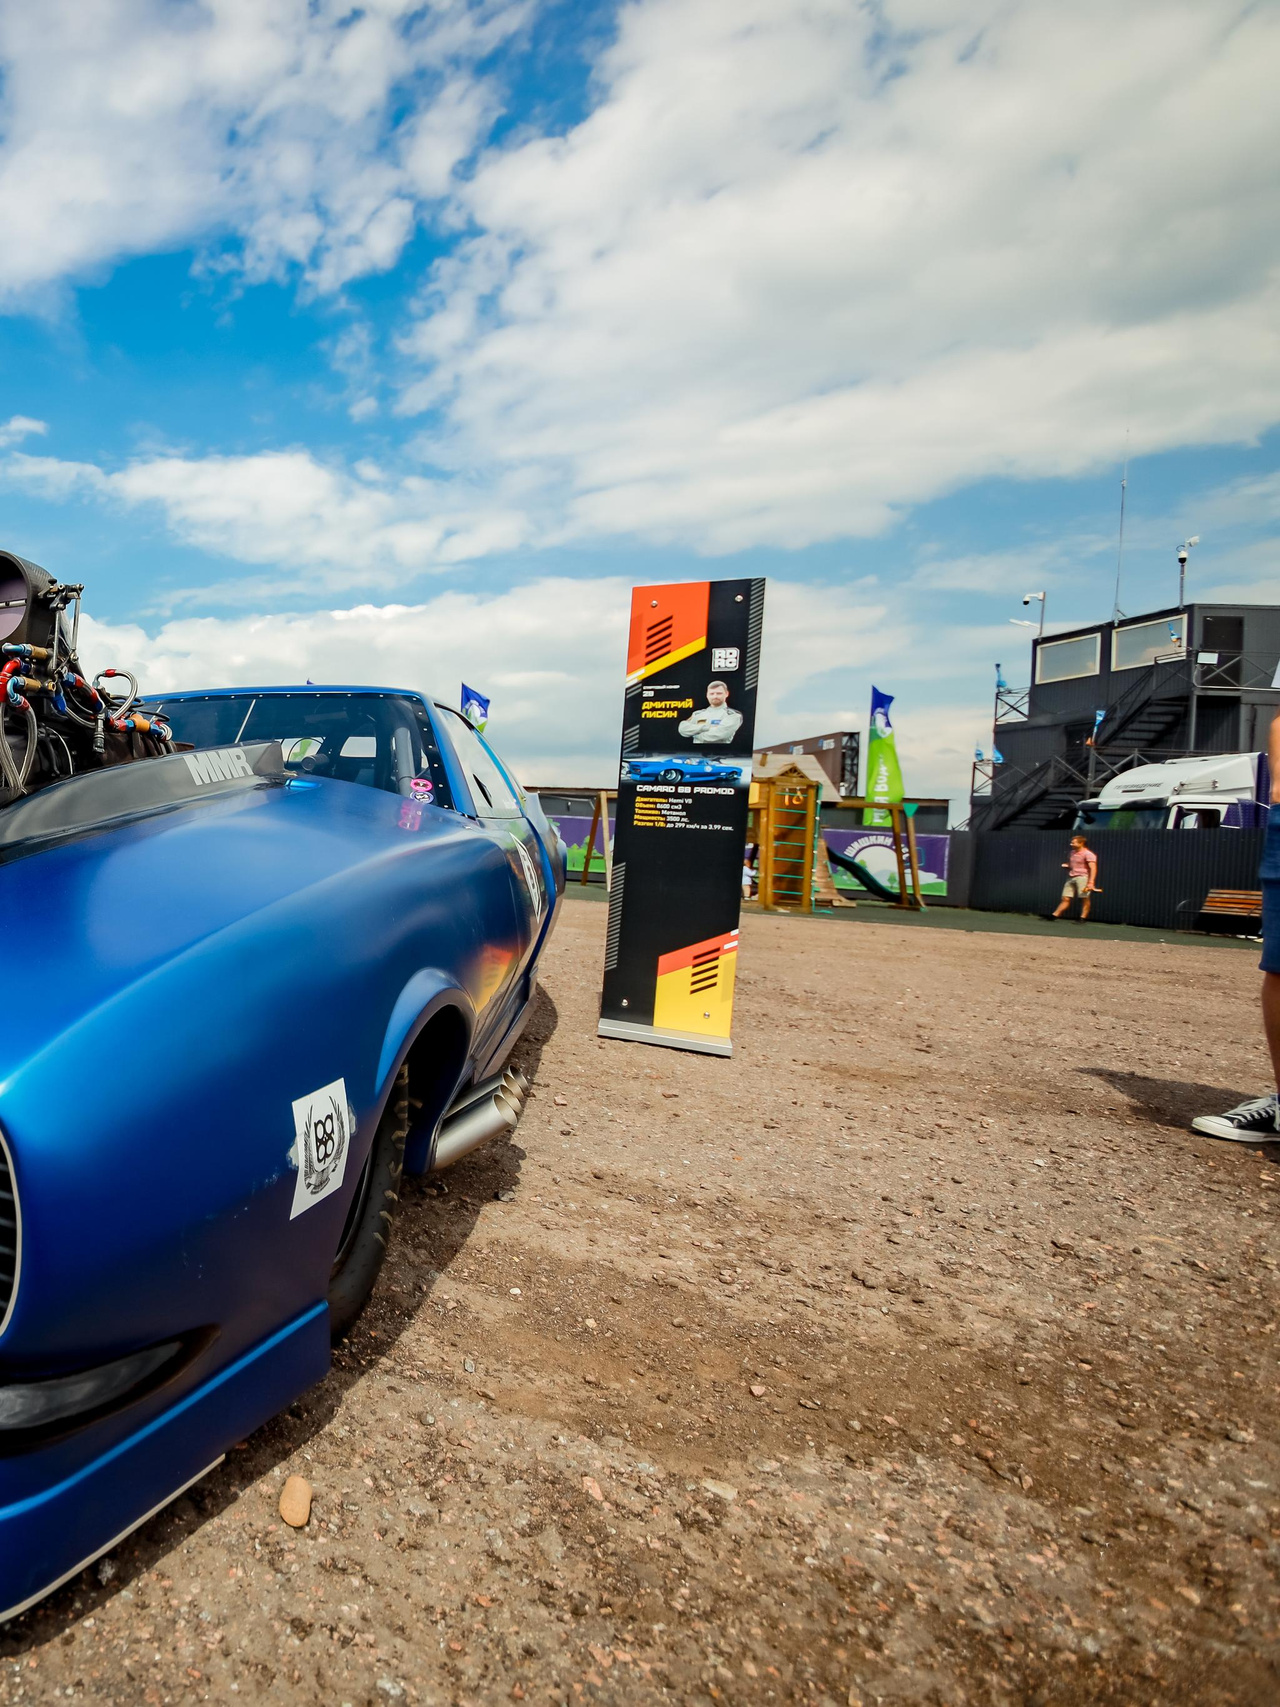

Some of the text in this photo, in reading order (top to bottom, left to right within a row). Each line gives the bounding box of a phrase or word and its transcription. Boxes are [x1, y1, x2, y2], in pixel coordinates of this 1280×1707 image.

[642, 698, 693, 710] ДМИТРИЙ
[642, 710, 678, 718] ЛИСИН
[183, 748, 254, 786] MMR
[693, 786, 735, 795] PROMOD
[843, 835, 893, 858] ШИШКИН
